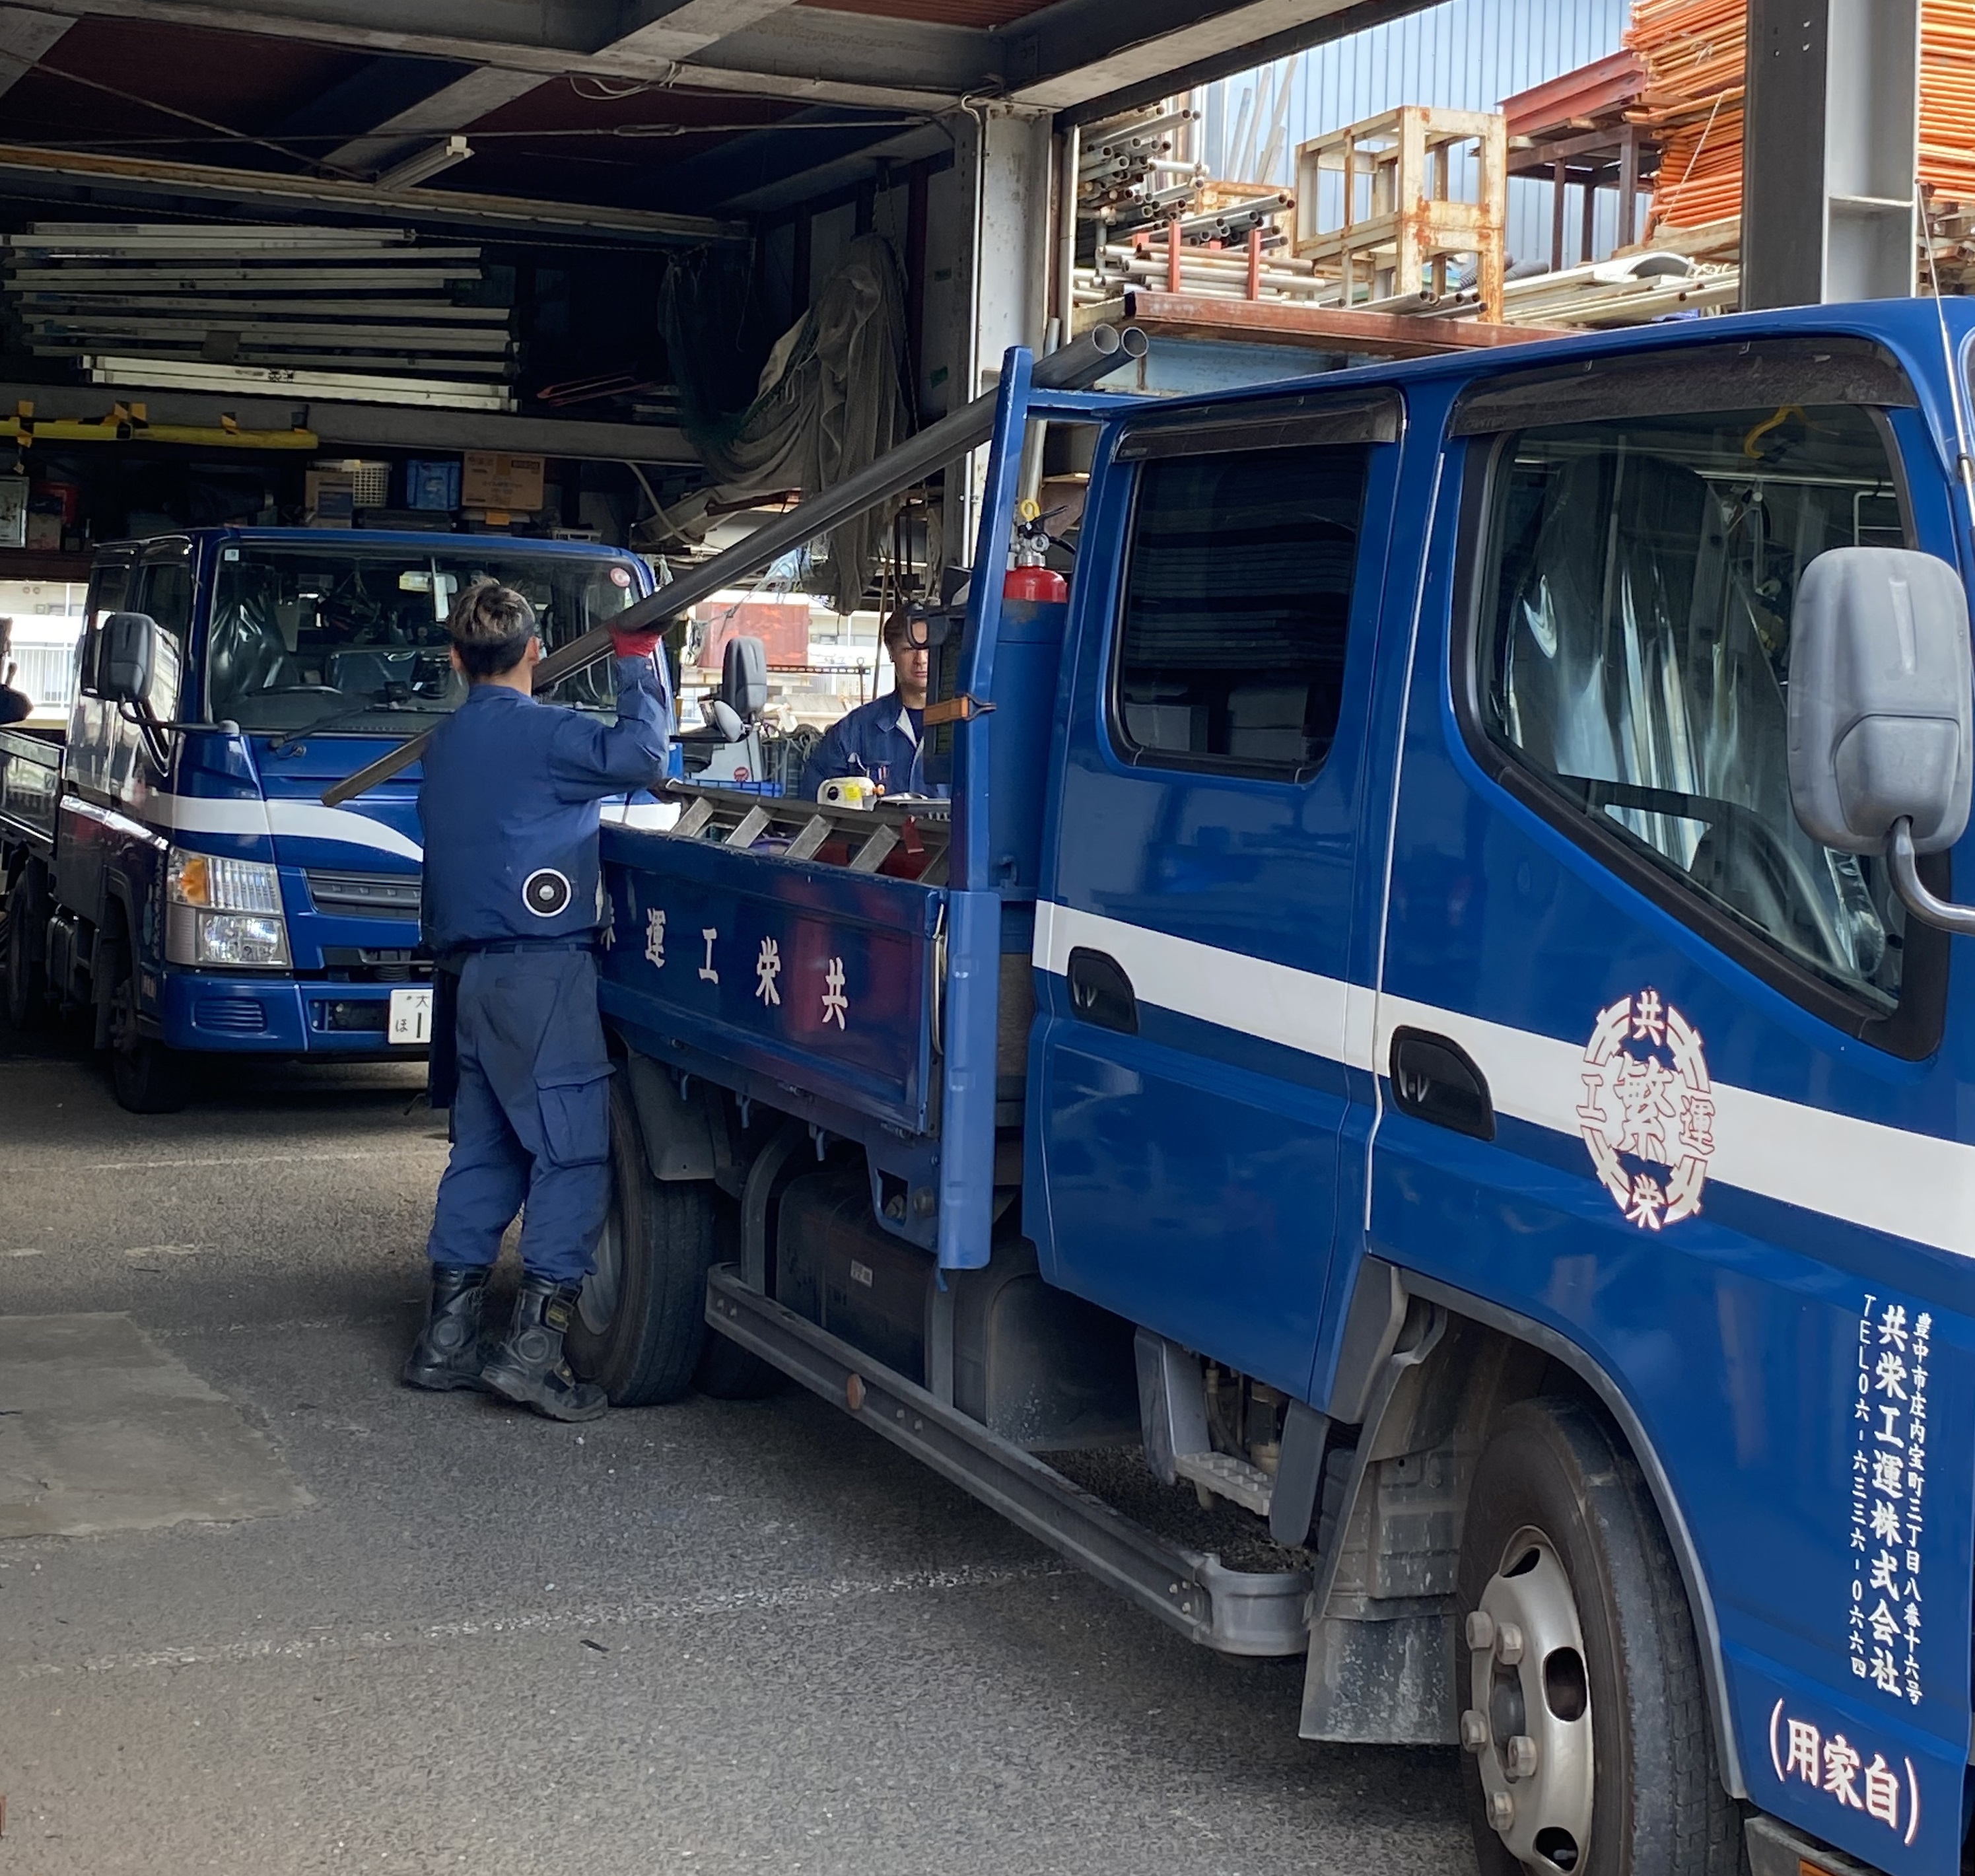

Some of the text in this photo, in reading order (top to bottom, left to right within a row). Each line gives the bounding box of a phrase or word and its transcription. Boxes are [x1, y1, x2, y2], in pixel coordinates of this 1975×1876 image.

[1868, 1305, 1908, 1698] 共栄工運株式会社
